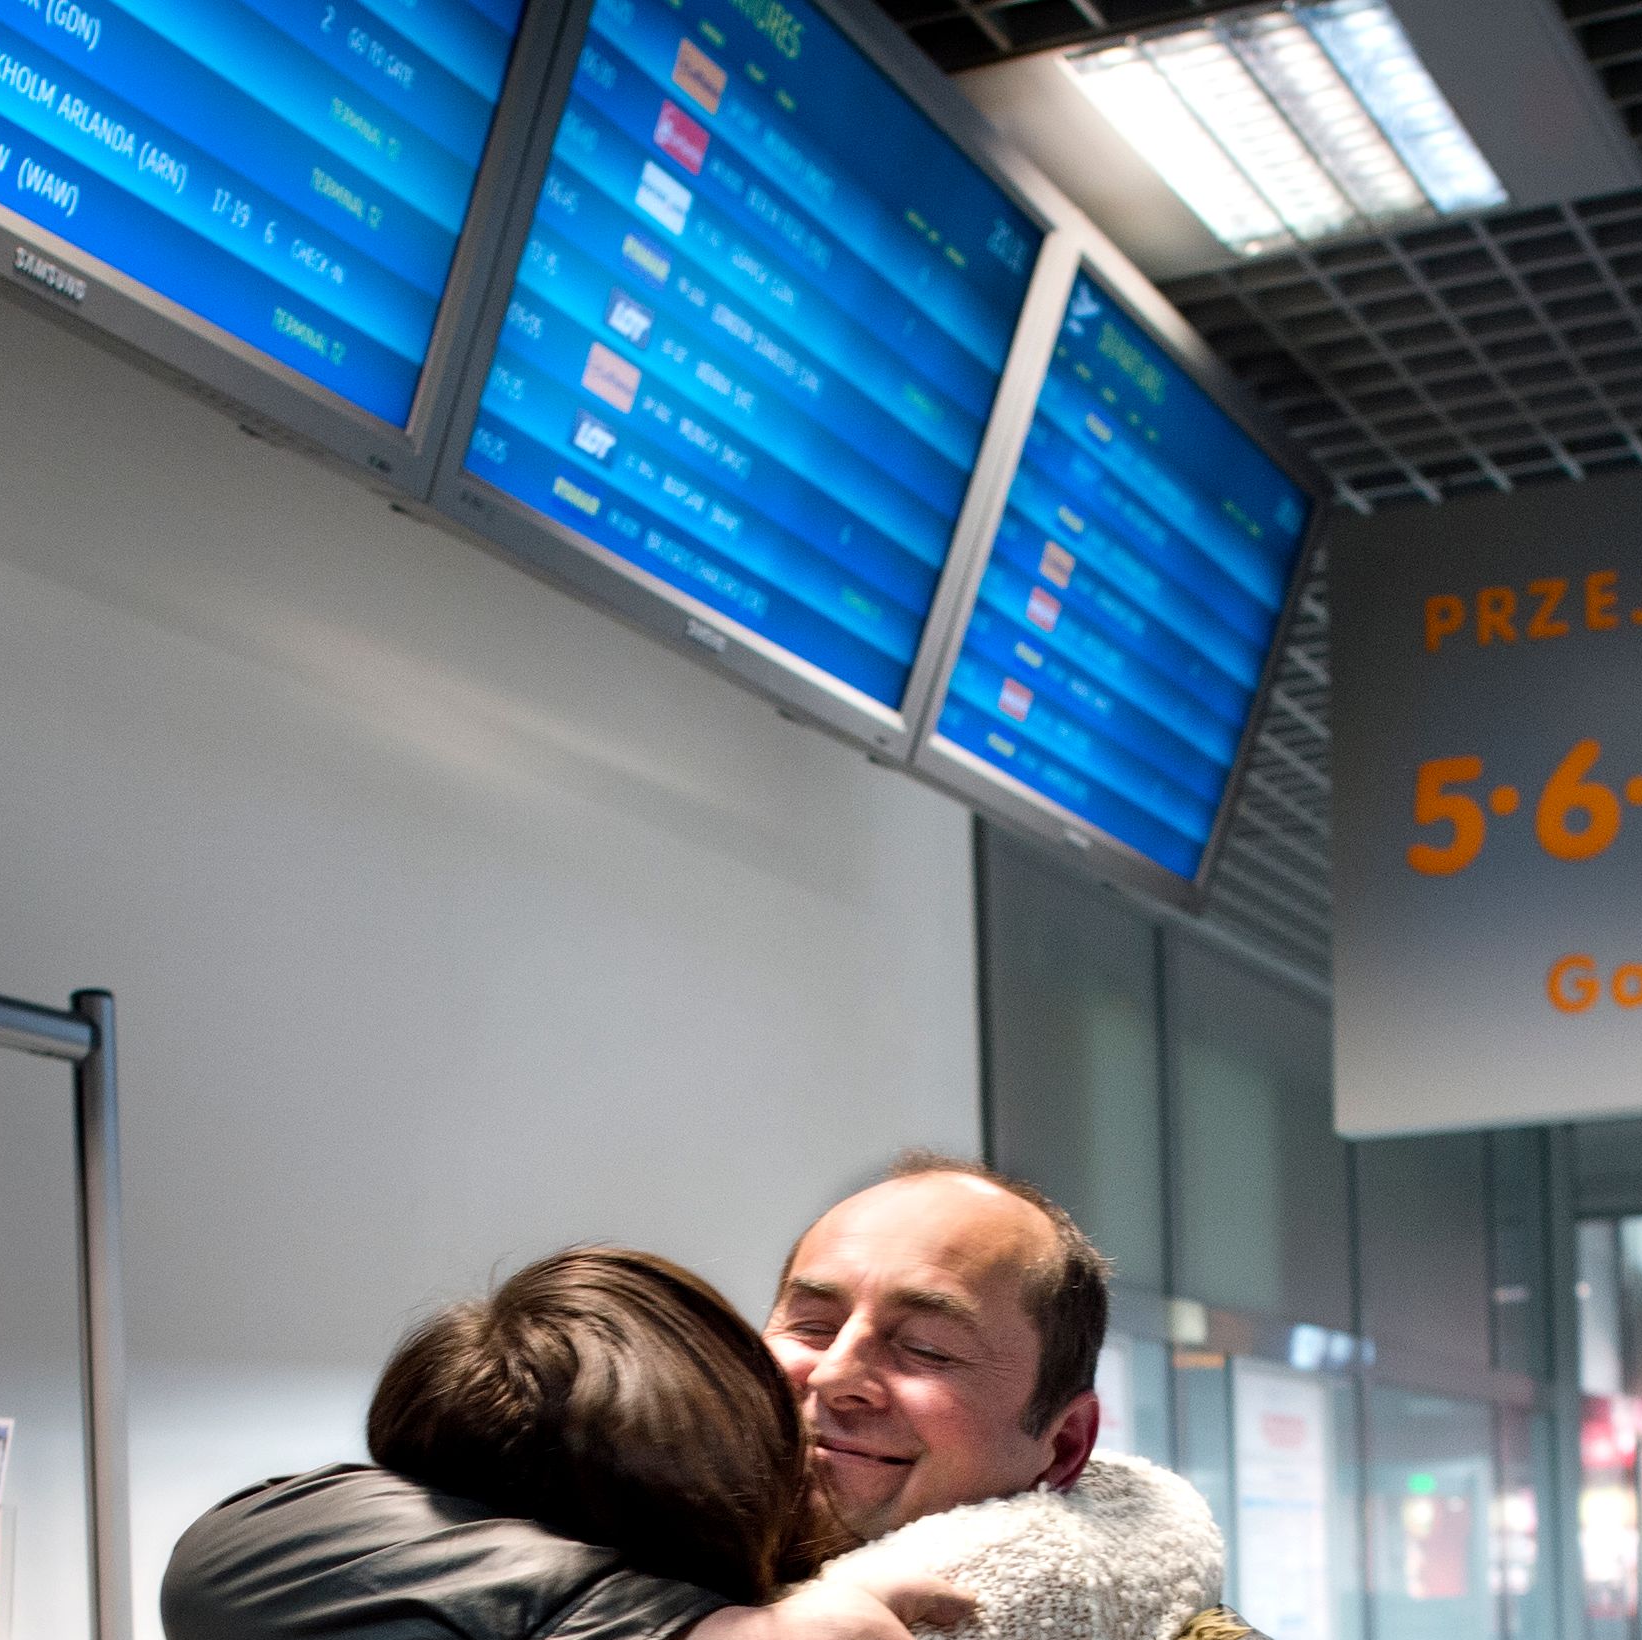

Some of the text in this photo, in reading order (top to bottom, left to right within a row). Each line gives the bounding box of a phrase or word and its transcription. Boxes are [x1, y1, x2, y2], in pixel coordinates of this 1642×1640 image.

[57, 93, 135, 158] ARLANDA
[138, 141, 189, 194] (ARN)
[17, 157, 80, 218] (WAW)
[13, 246, 86, 301] SAMSUNG
